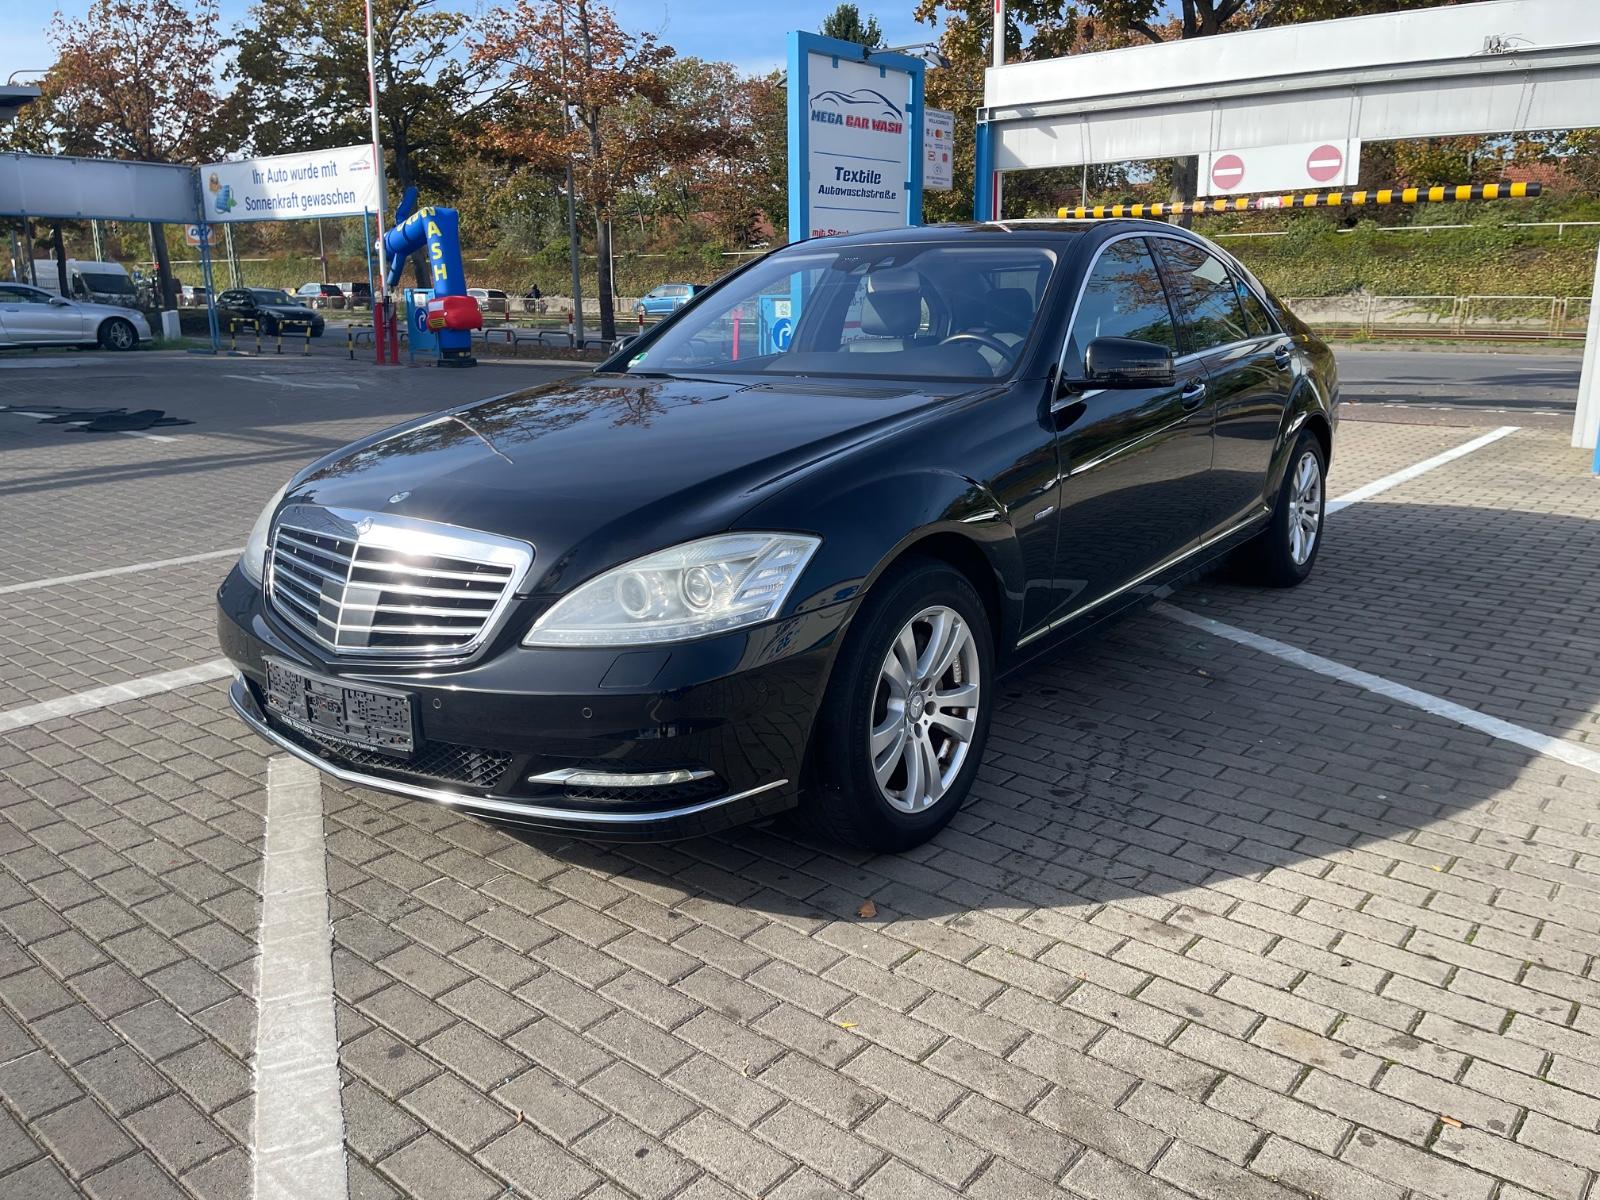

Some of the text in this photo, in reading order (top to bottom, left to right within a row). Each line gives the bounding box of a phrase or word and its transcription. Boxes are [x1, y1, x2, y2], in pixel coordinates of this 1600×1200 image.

[811, 109, 902, 134] MEGA CAR WASH
[252, 161, 338, 185] Ihr Auto wurde mit
[834, 166, 882, 185] Textile
[245, 187, 356, 211] Sonnenkraft gewaschen
